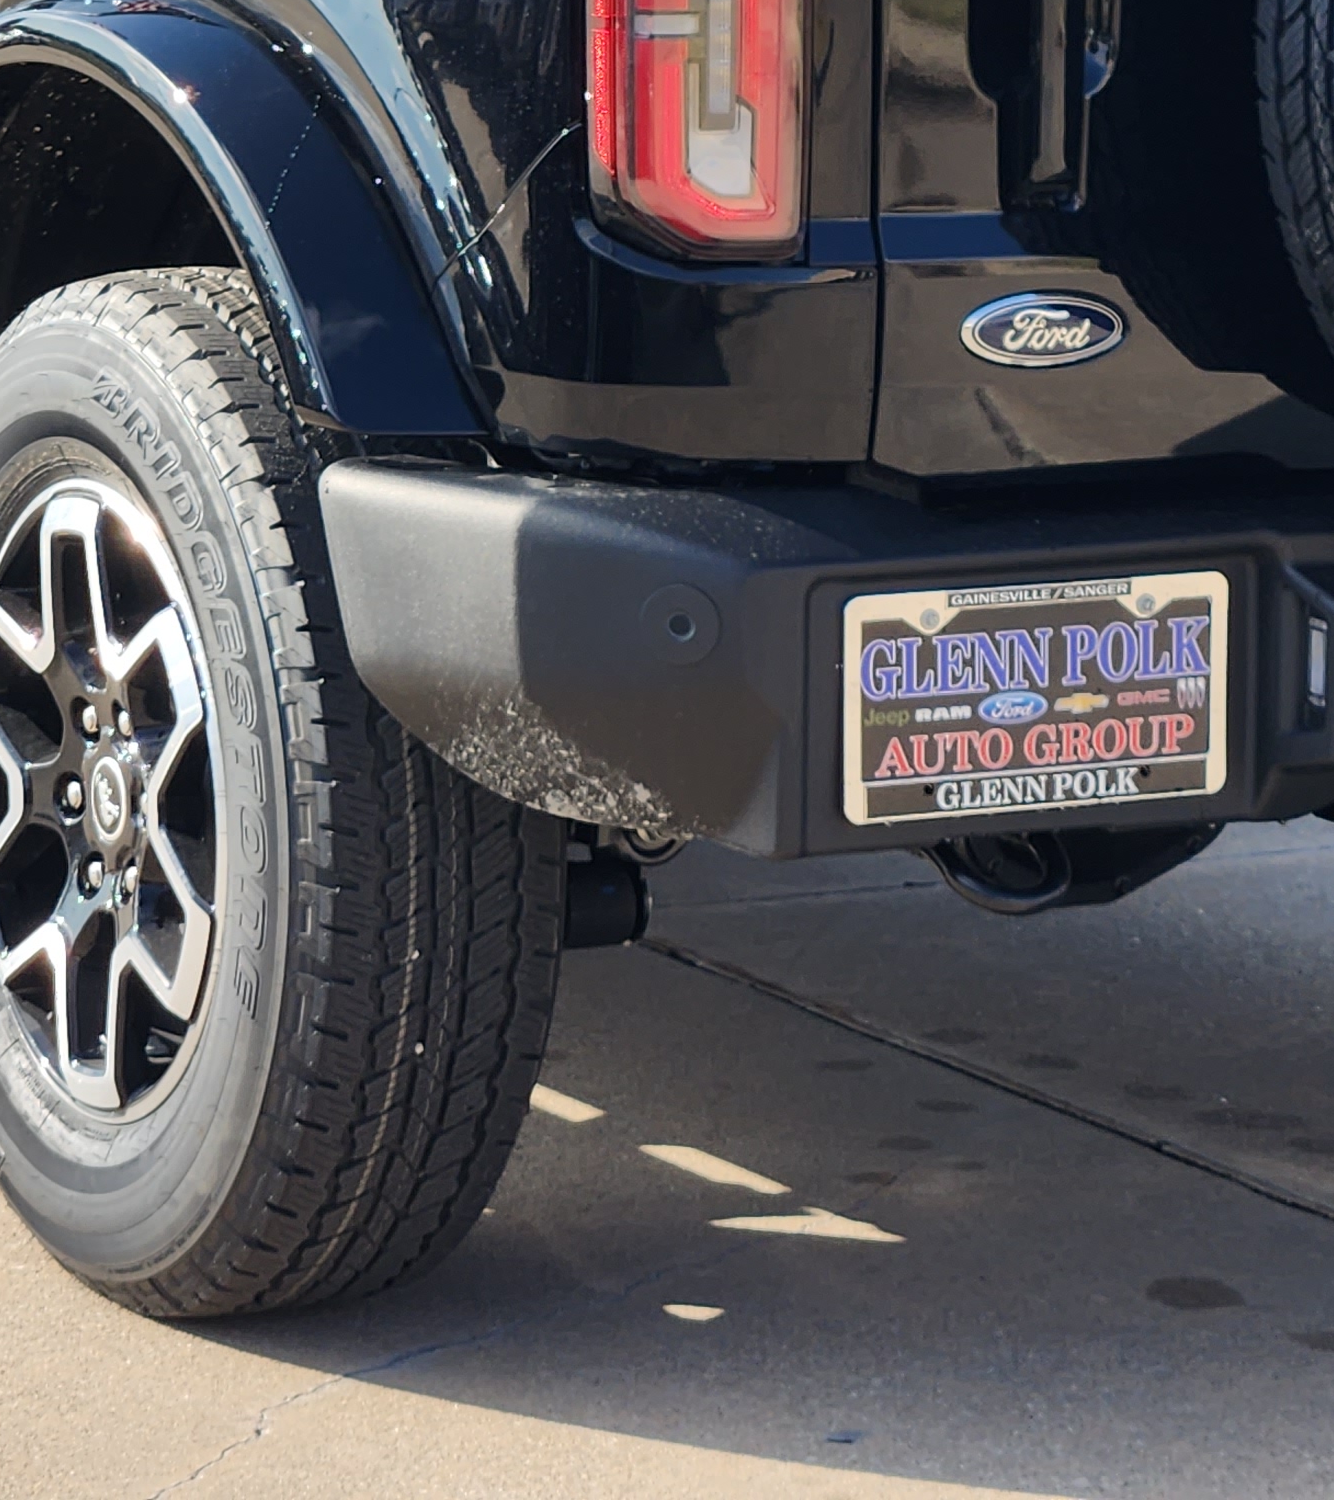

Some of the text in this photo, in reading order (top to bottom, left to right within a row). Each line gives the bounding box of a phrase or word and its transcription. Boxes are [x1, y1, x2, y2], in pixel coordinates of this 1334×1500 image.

[1002, 308, 1091, 351] Ford
[950, 582, 1129, 606] GAINESVILLE/SANGER
[860, 615, 1210, 700] GLENN POLK
[88, 366, 269, 1020] BRIDGESTONE
[864, 688, 1170, 728] Jeep RAM Ford GMC
[874, 713, 1195, 778] AUTO GROUP
[936, 767, 1139, 810] GLENN POLK
